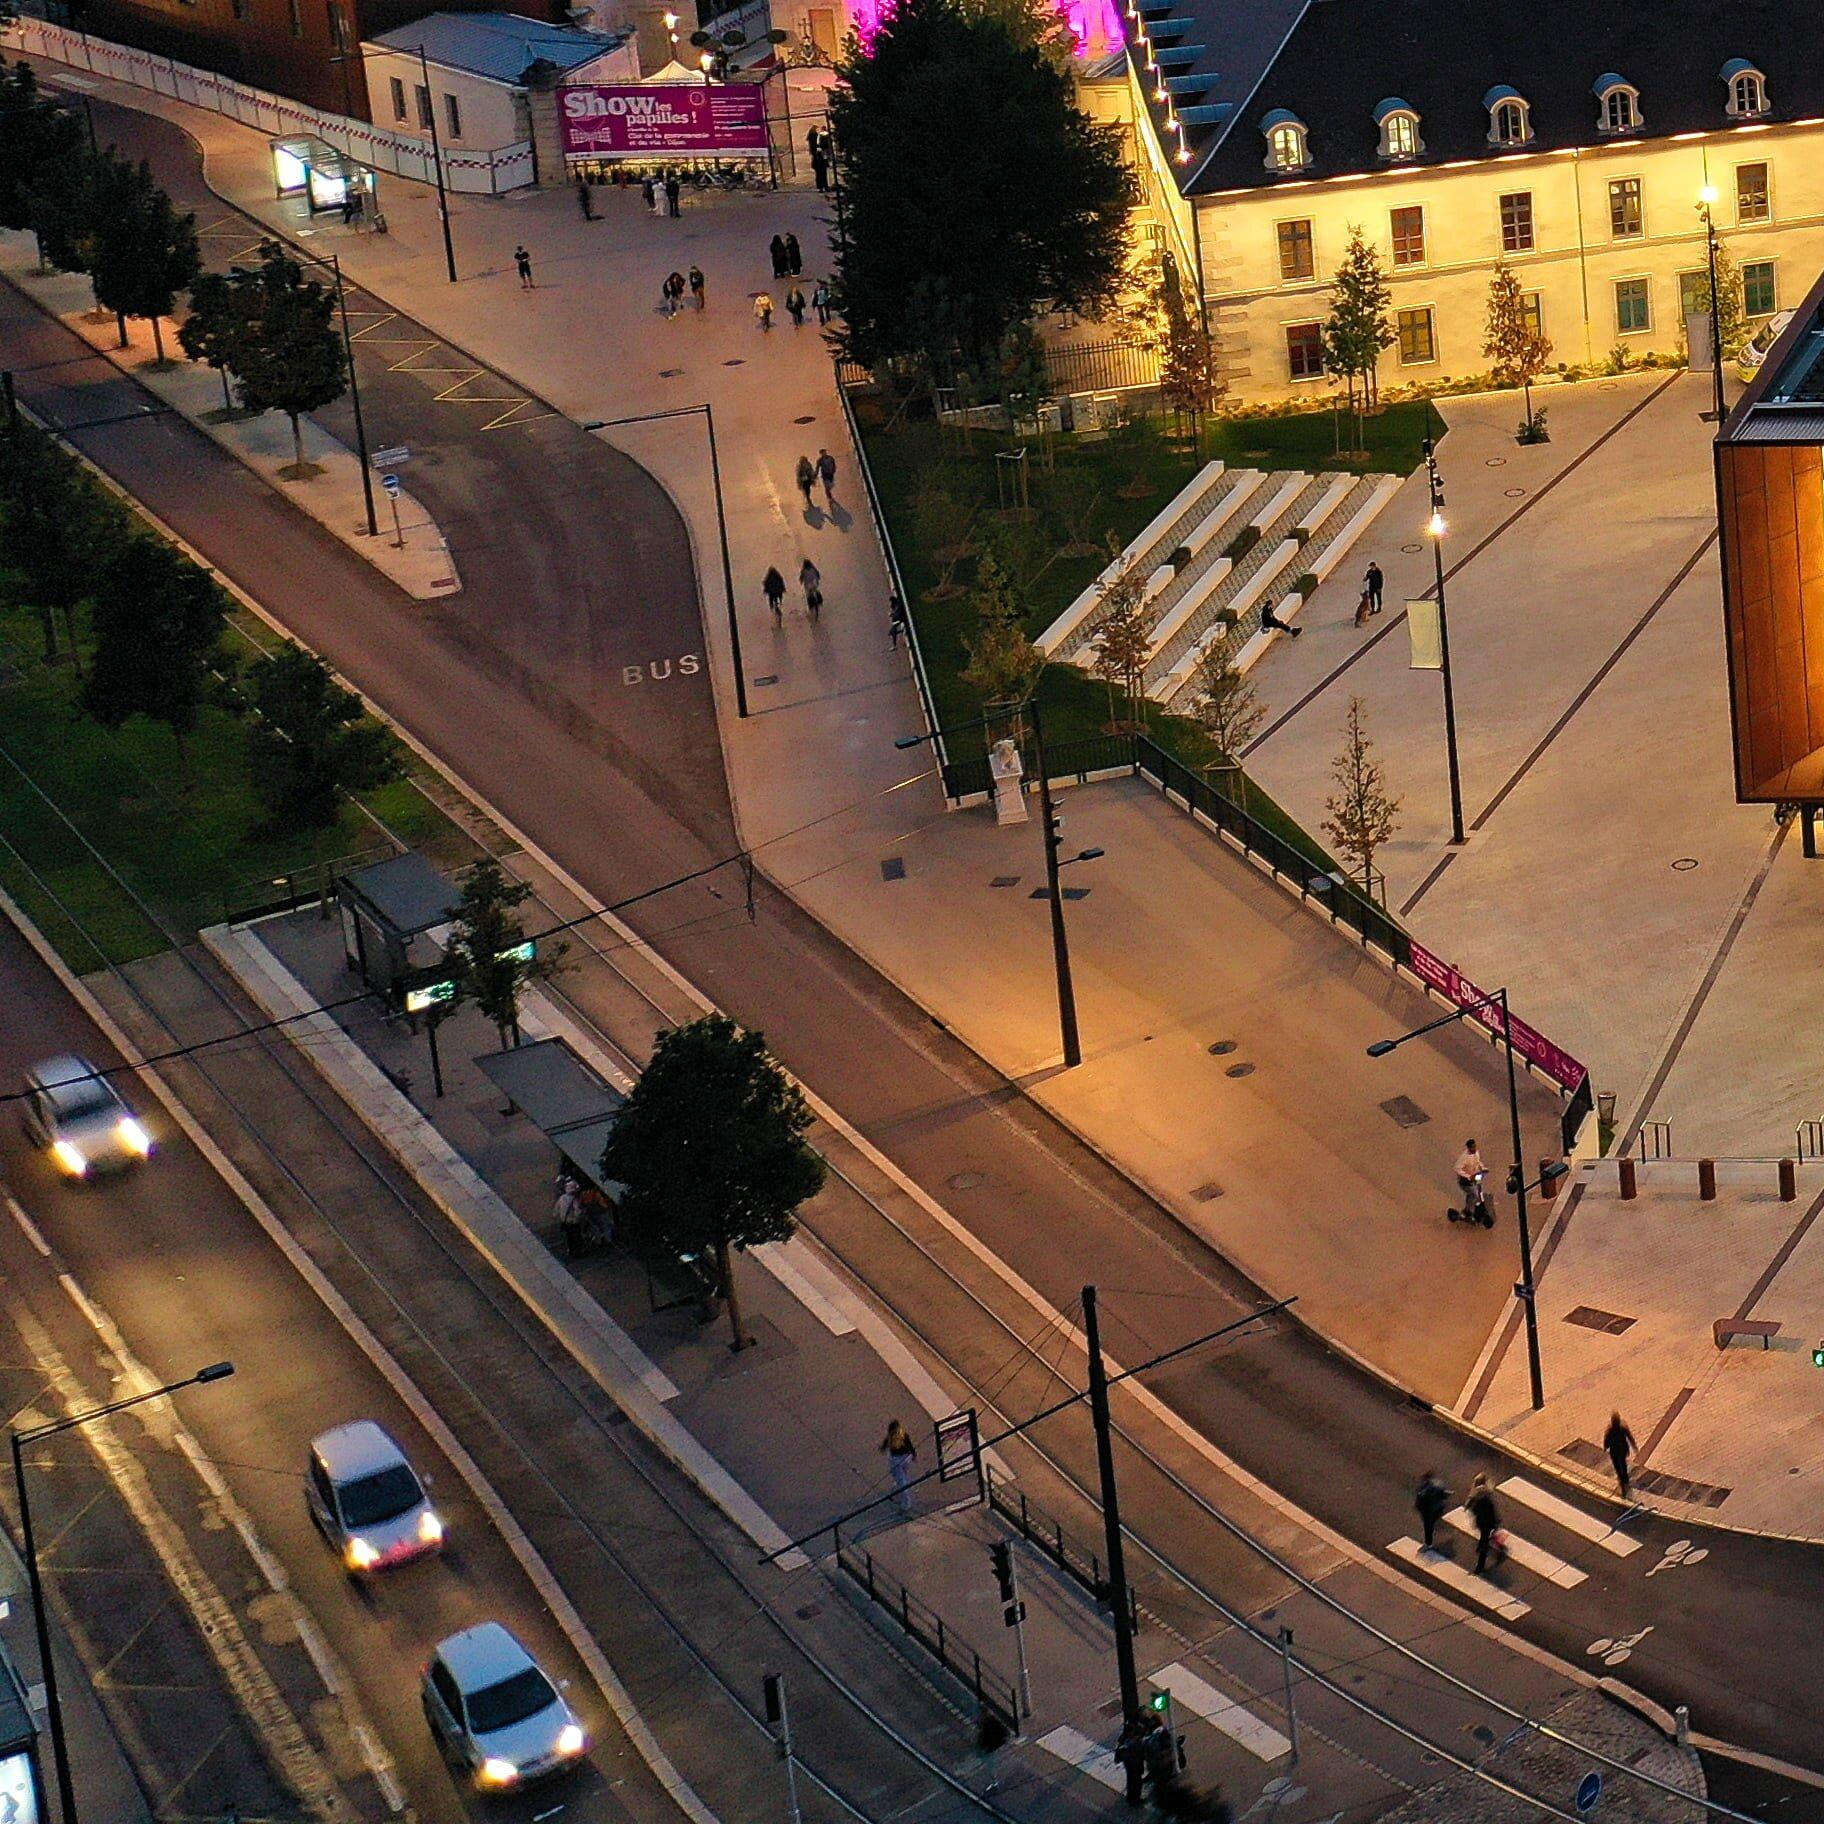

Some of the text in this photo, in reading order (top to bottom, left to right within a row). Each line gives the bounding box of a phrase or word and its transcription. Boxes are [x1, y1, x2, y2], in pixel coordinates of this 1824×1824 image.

[564, 91, 656, 118] Show
[626, 111, 689, 127] papilles
[622, 654, 700, 686] BUS
